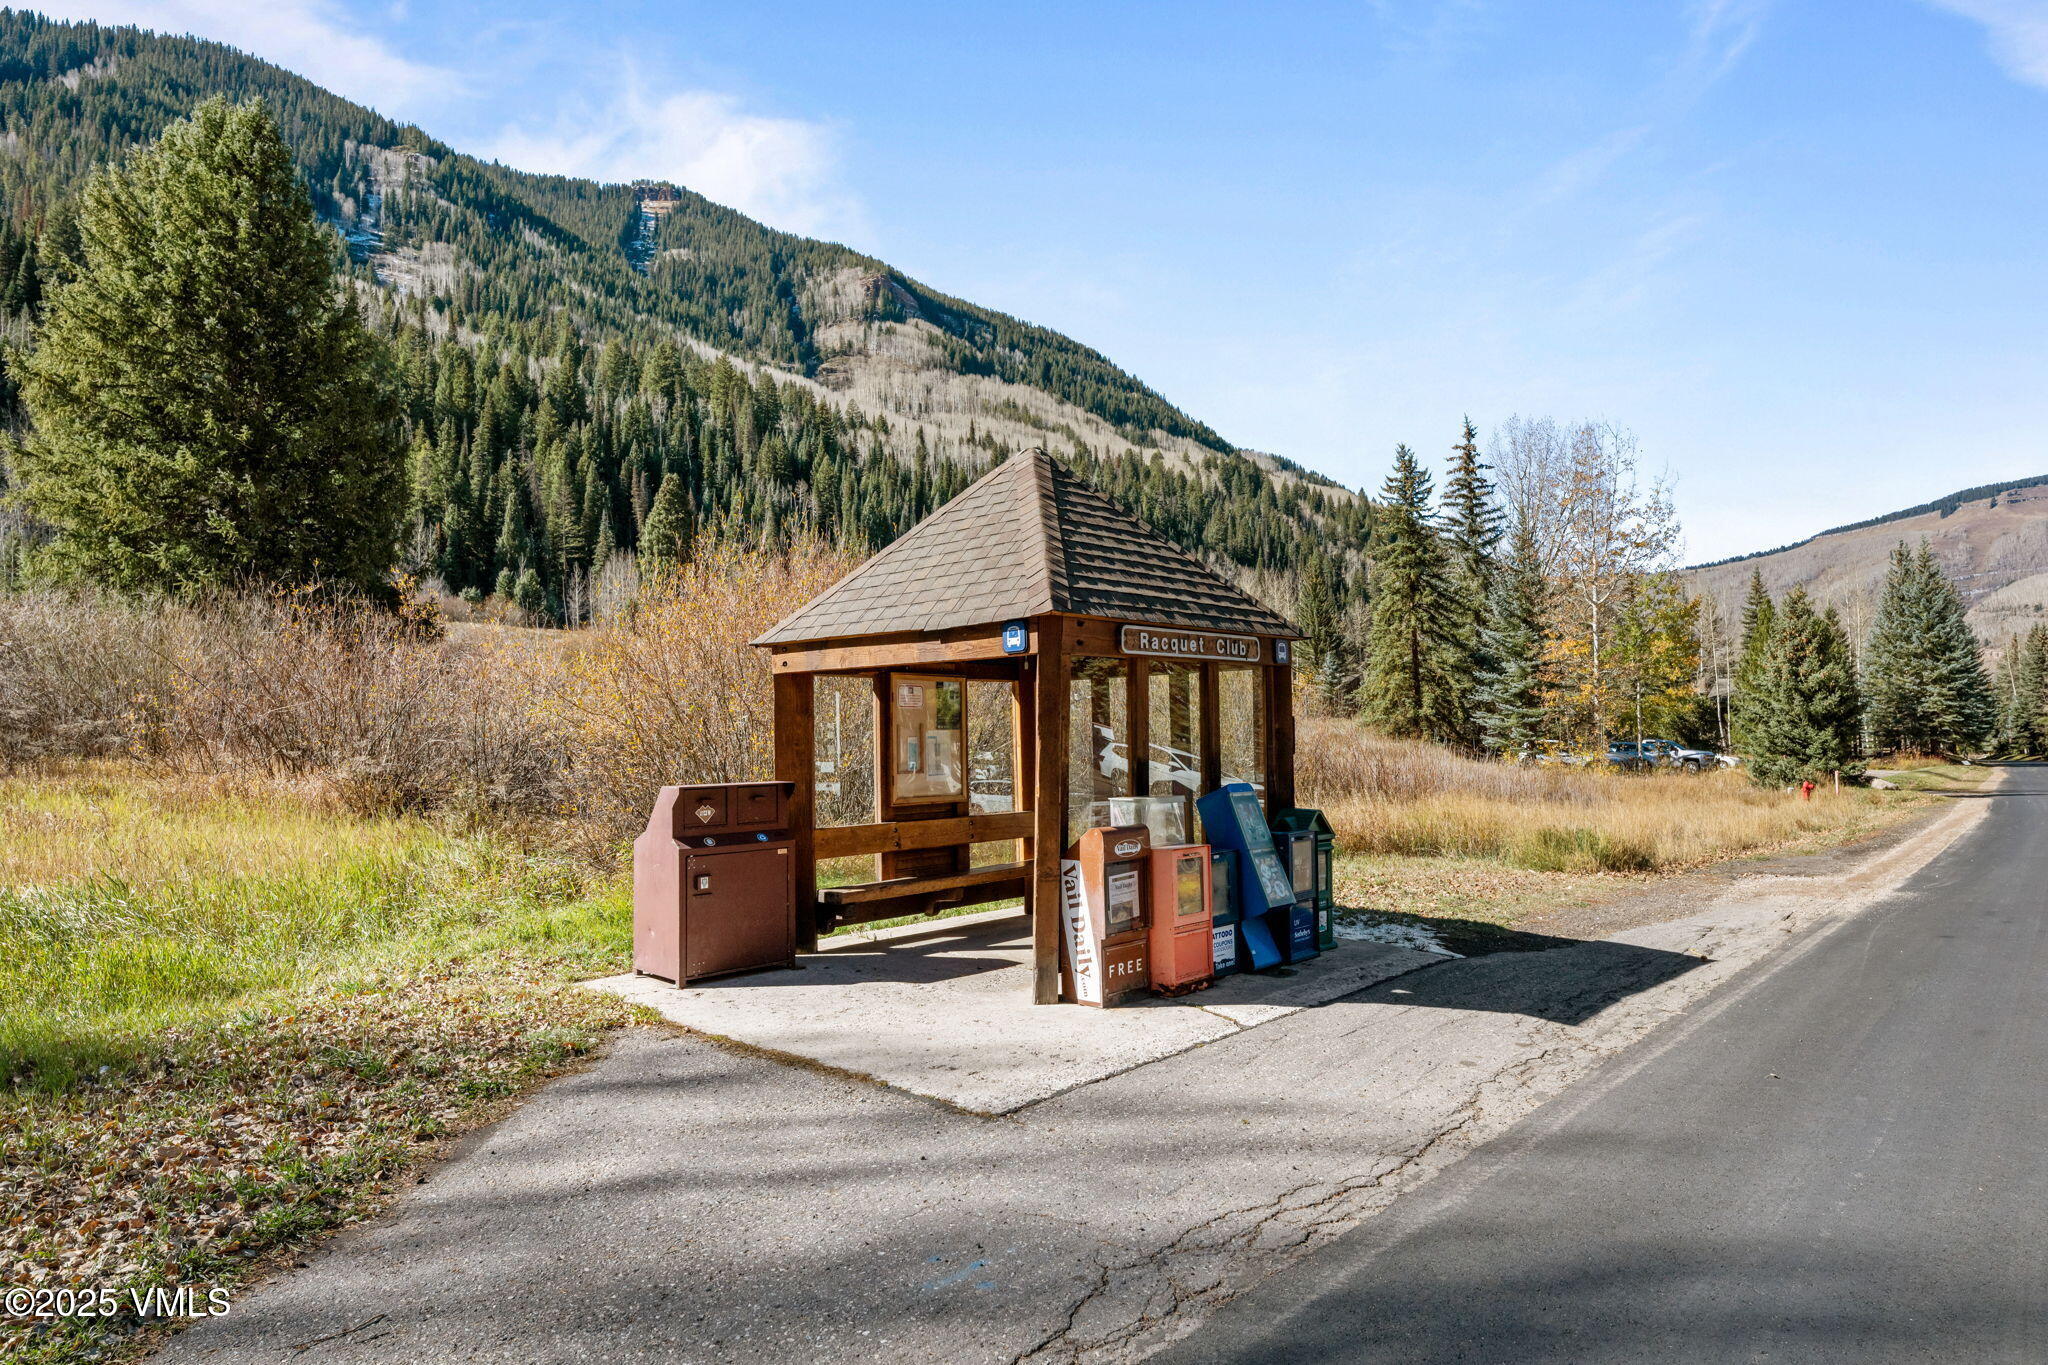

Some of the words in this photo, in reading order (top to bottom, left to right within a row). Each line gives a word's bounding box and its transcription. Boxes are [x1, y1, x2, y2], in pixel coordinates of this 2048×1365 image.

[1140, 632, 1204, 654] Racquet
[1216, 639, 1246, 656] Club
[1063, 862, 1082, 910] Vail
[1109, 958, 1142, 979] FREE
